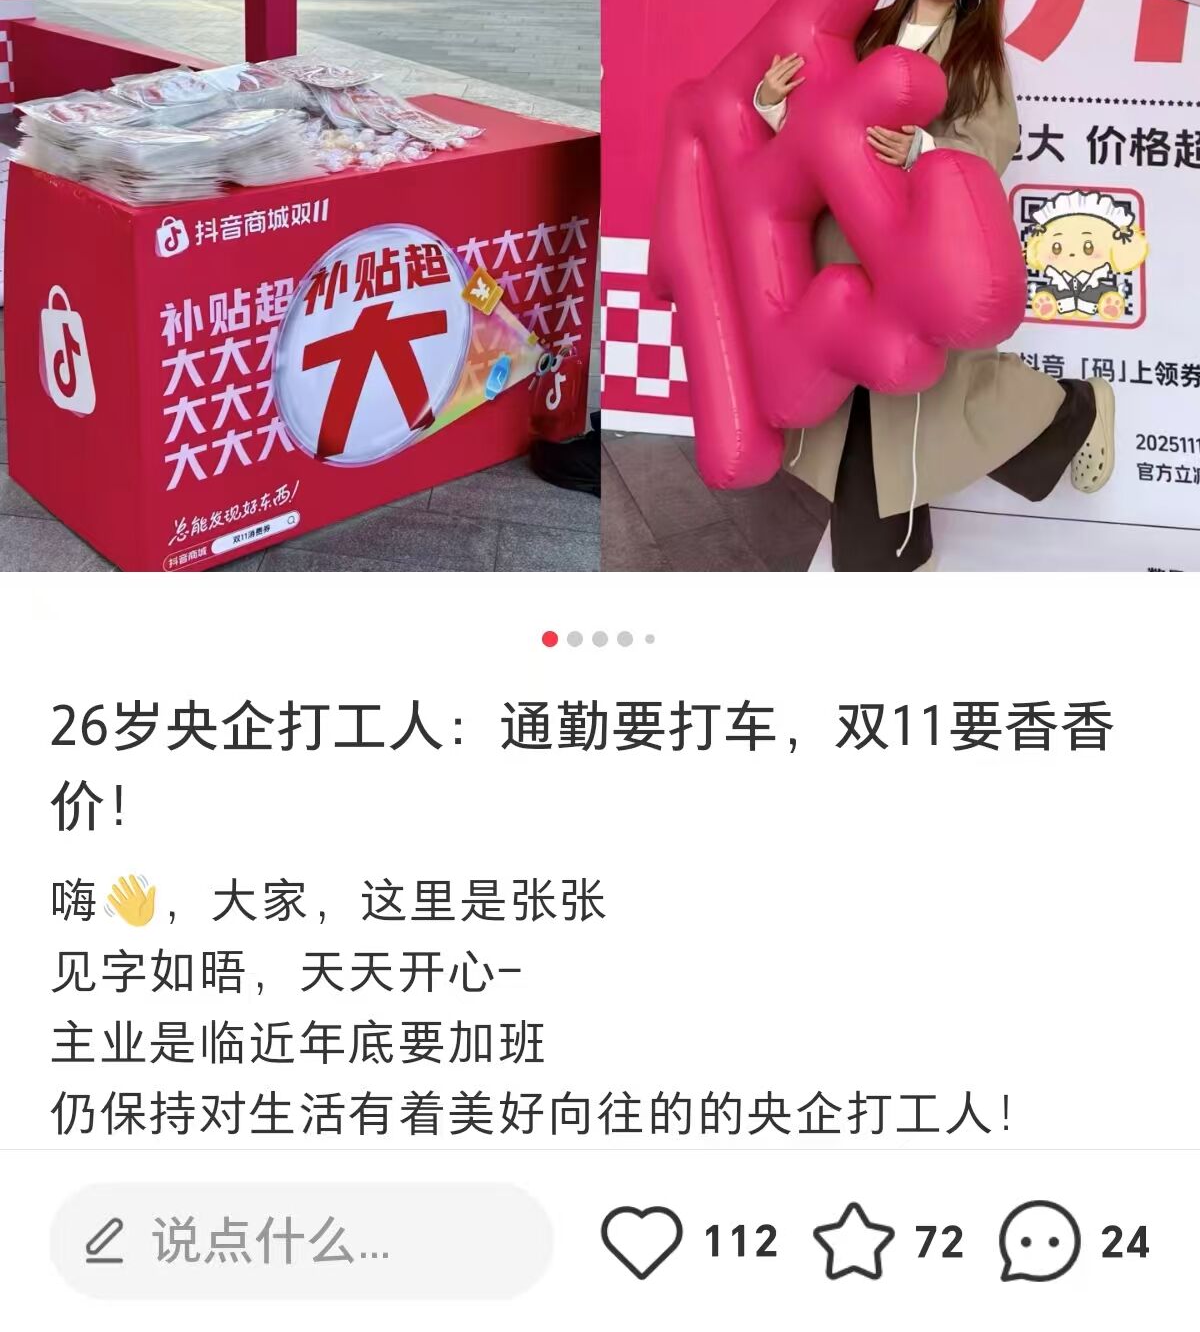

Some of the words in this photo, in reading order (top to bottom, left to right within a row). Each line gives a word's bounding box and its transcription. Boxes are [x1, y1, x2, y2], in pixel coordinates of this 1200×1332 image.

[195, 198, 330, 246] 抖音商城双11
[302, 243, 451, 316] 补贴超
[159, 276, 294, 347] 补贴超
[302, 300, 448, 463] 大
[167, 546, 208, 569] 抖音商城
[51, 700, 1115, 754] 26岁央企打工人：通勤要打车，双11要香香
[51, 1018, 545, 1065] 主业是临近年底要加班
[705, 1224, 778, 1258] 112
[915, 1224, 964, 1259] 72
[1101, 1224, 1150, 1259] 24
